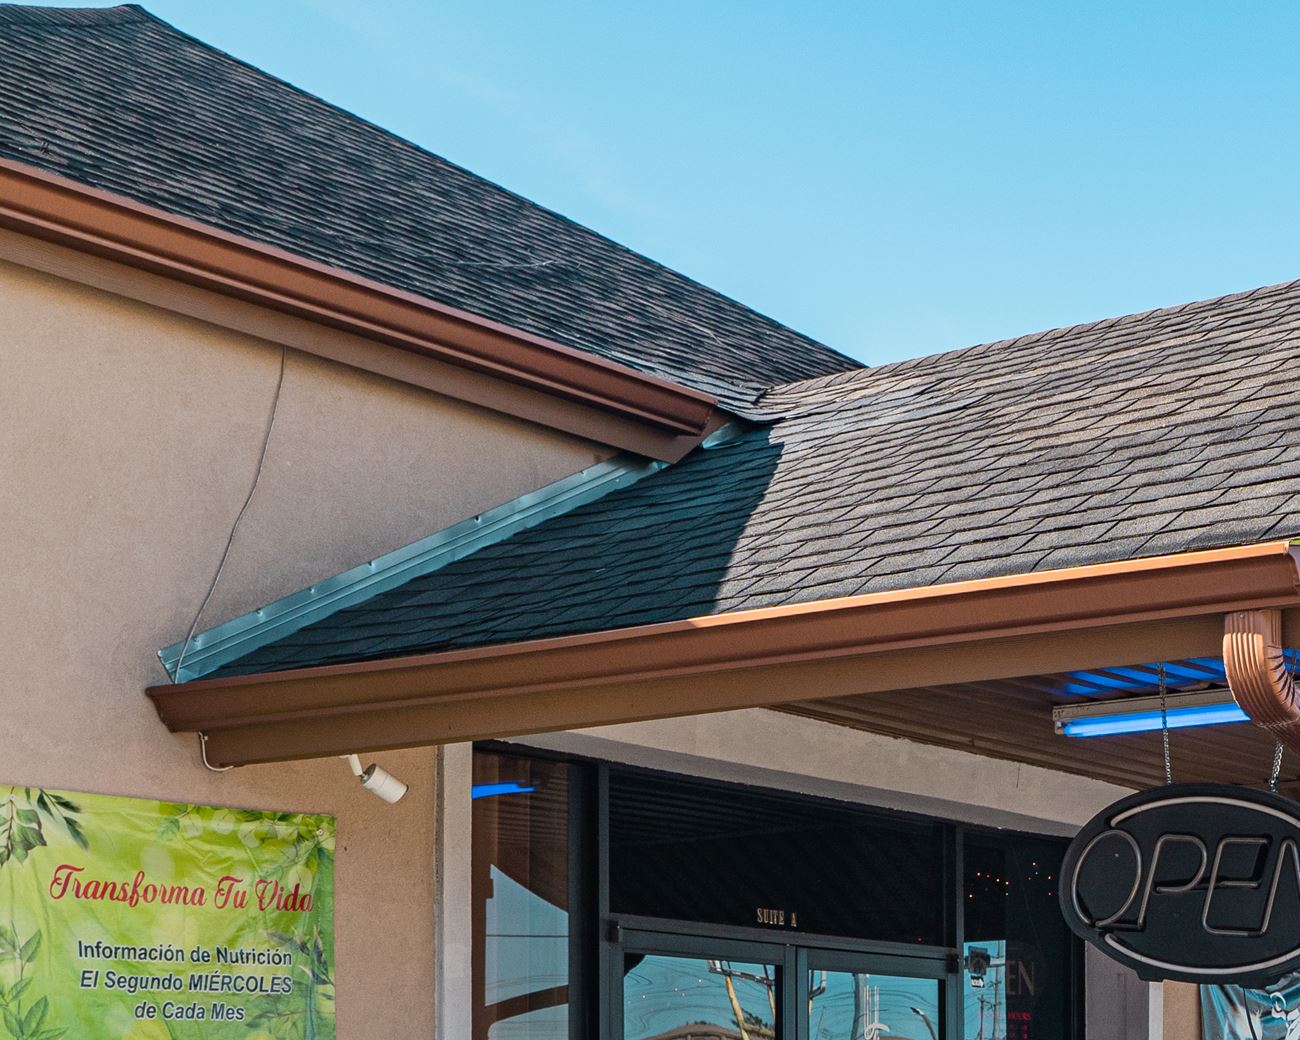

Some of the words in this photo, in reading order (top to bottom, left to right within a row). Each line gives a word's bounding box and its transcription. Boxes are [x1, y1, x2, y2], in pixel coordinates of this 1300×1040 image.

[49, 863, 208, 908] Transforma
[213, 875, 247, 910] Tu
[254, 878, 313, 913] Vida
[756, 907, 785, 926] SUITE
[790, 911, 798, 928] A
[78, 940, 186, 964] Información
[189, 944, 211, 964] de
[215, 946, 293, 967] Nutrición
[80, 970, 98, 989] El
[104, 971, 184, 995] Segundo
[187, 970, 293, 995] MIÉRCOLES
[134, 1002, 157, 1020] de
[162, 1002, 207, 1020] Cada
[210, 1003, 245, 1022] Mes
